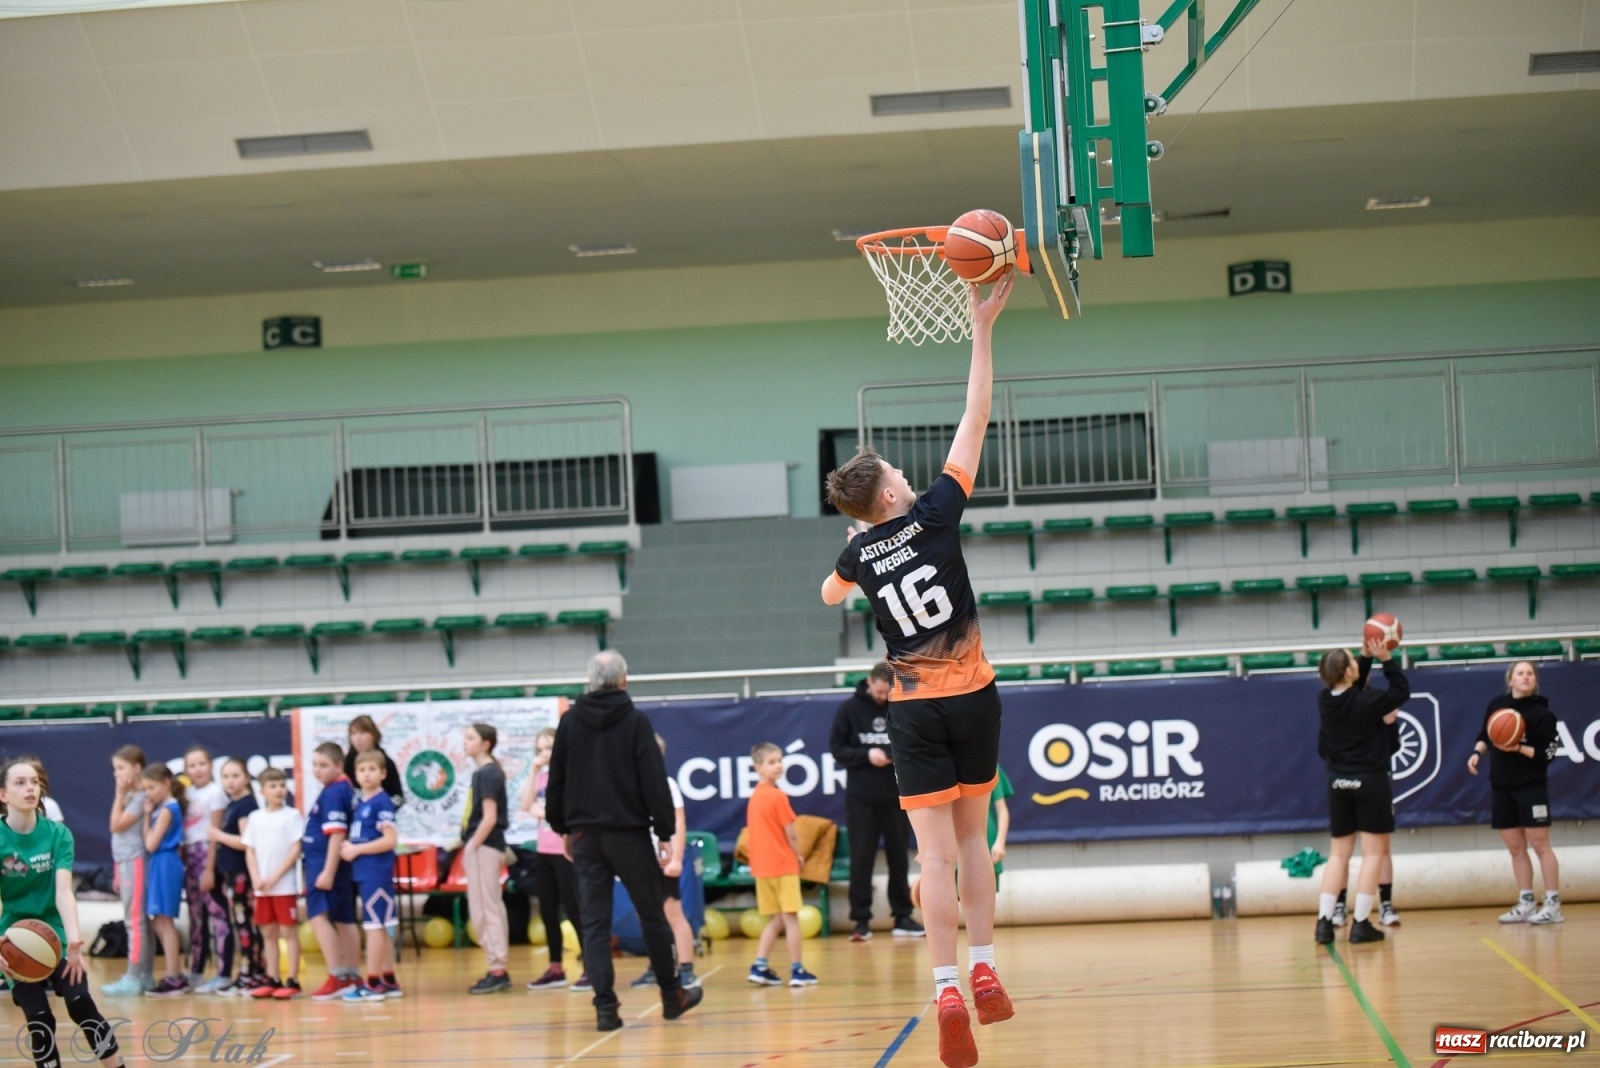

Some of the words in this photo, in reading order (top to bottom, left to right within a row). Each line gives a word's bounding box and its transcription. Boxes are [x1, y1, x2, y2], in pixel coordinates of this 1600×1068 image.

[1233, 272, 1256, 293] D
[1265, 271, 1287, 290] D
[266, 327, 281, 346] C
[291, 325, 316, 345] C
[871, 545, 919, 576] WĘGIEL
[877, 564, 954, 637] 16
[1028, 719, 1204, 782] OSiR
[1099, 778, 1205, 802] RACIBÓRZ
